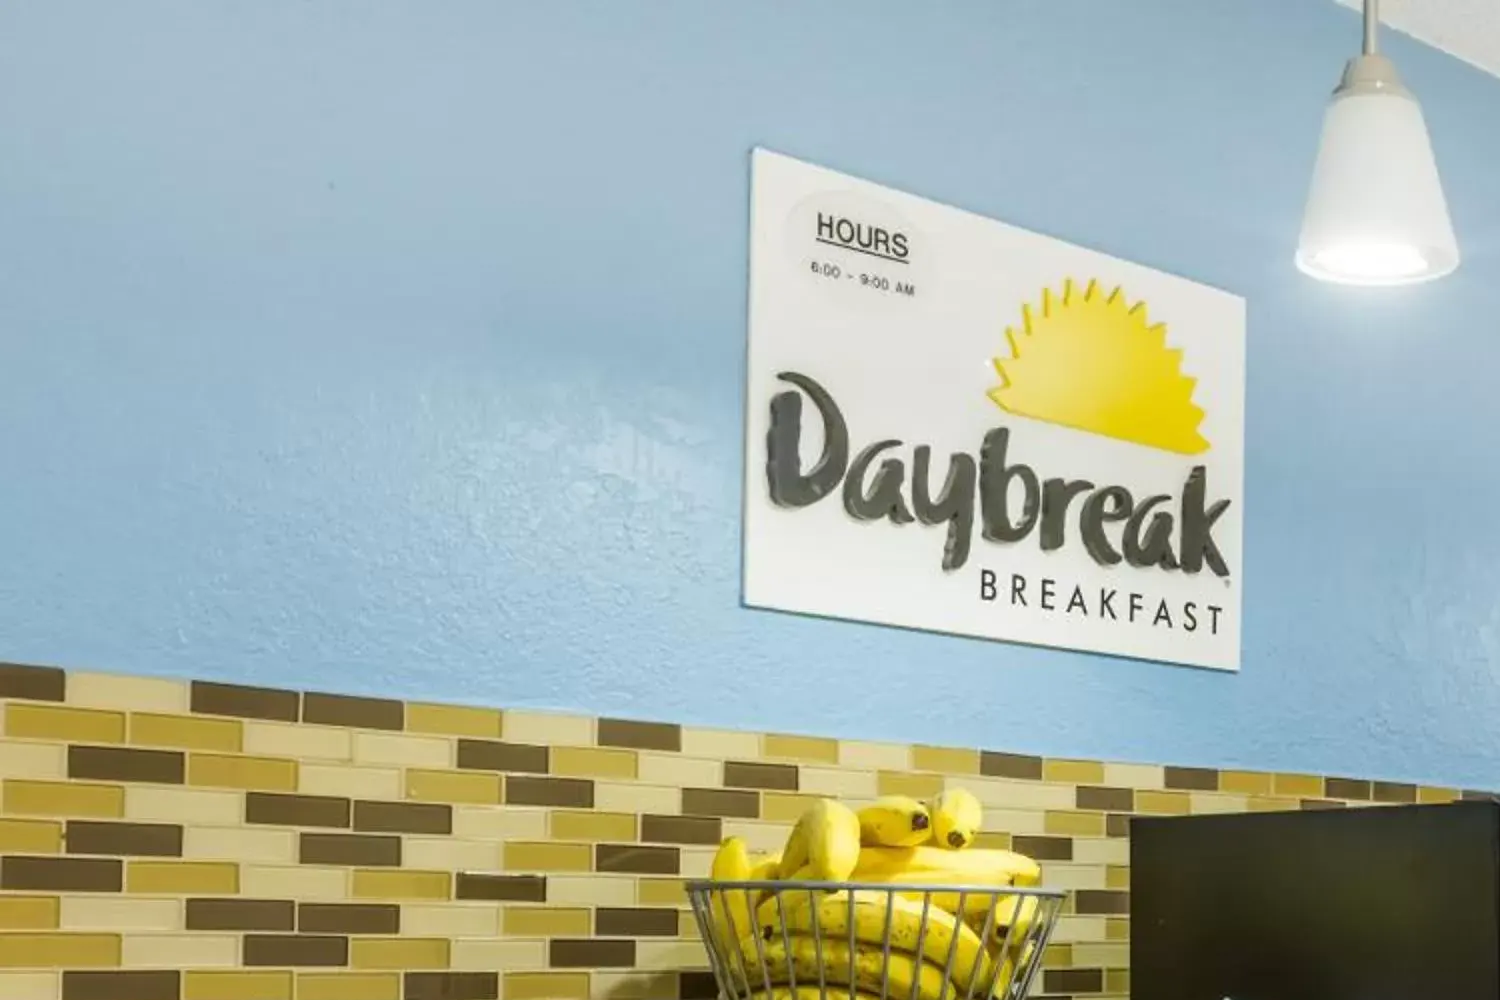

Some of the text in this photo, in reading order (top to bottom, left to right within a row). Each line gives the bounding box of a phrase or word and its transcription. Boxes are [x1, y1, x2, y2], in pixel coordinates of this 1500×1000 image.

[816, 211, 909, 259] HOURS
[811, 261, 841, 279] 6:00
[860, 273, 889, 291] 9:00
[896, 281, 915, 296] AM
[766, 370, 1231, 578] Daybreak
[980, 568, 1223, 634] BREAKFAST
